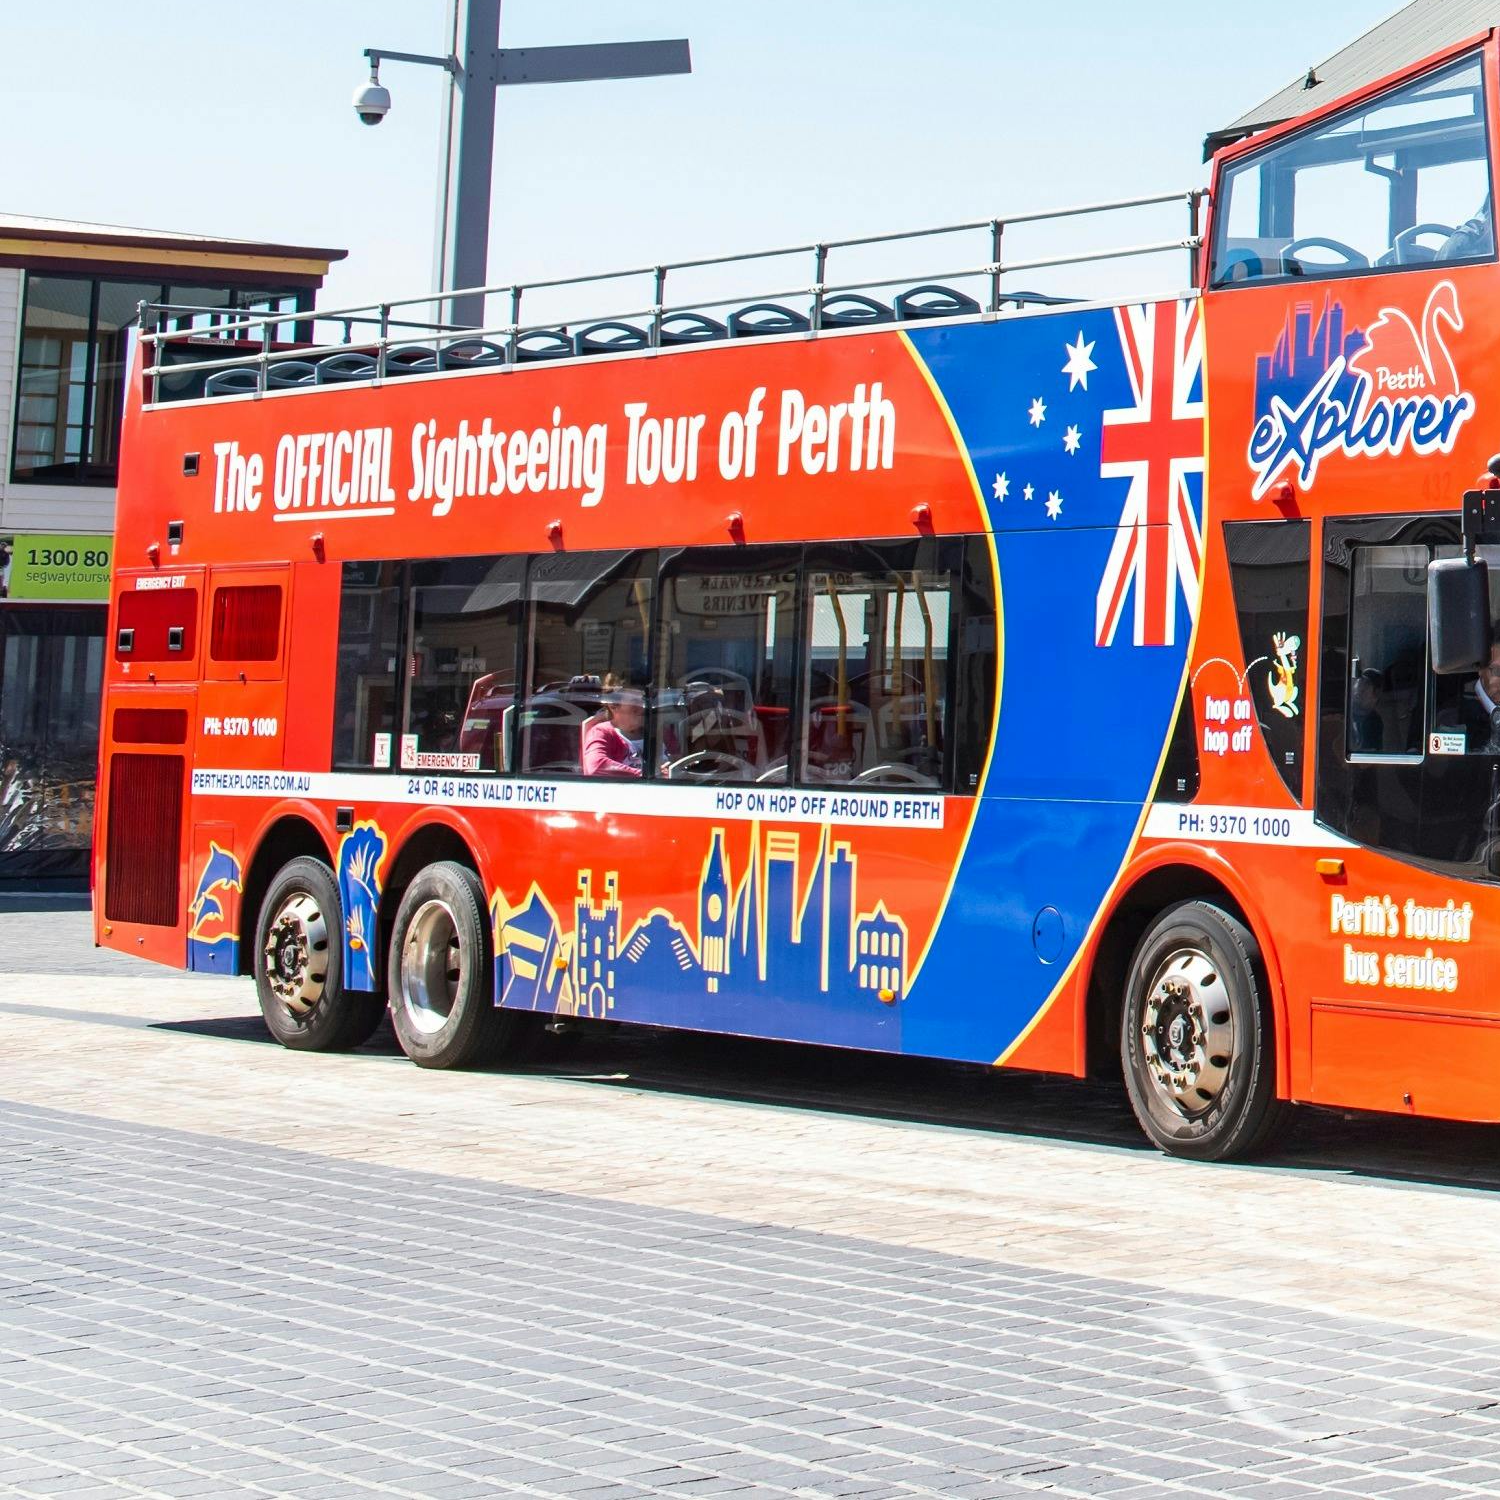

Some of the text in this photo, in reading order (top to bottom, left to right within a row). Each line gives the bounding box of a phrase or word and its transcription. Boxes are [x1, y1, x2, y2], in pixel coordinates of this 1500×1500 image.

[1376, 364, 1425, 390] Perth
[213, 381, 896, 517] The OFFICIAL Sightseeing Tour of Perth
[27, 549, 78, 567] 1300
[171, 576, 186, 588] EXIT
[1205, 695, 1250, 724] hop on
[203, 717, 278, 737] PH: 9370 1000
[1204, 725, 1253, 756] hop off
[417, 754, 479, 769] EMERGENCY EXIT
[194, 773, 311, 792] PERTHEXPLORER.COM.AU
[408, 779, 557, 803] 24 OR 48 HRS VALID TICKET
[716, 792, 940, 820] HOP ON HOP OFF AROUND PERTH
[1178, 812, 1291, 837] PH: 9370 1000
[1331, 893, 1474, 943] Perth's tourist
[1343, 943, 1459, 993] bus service
